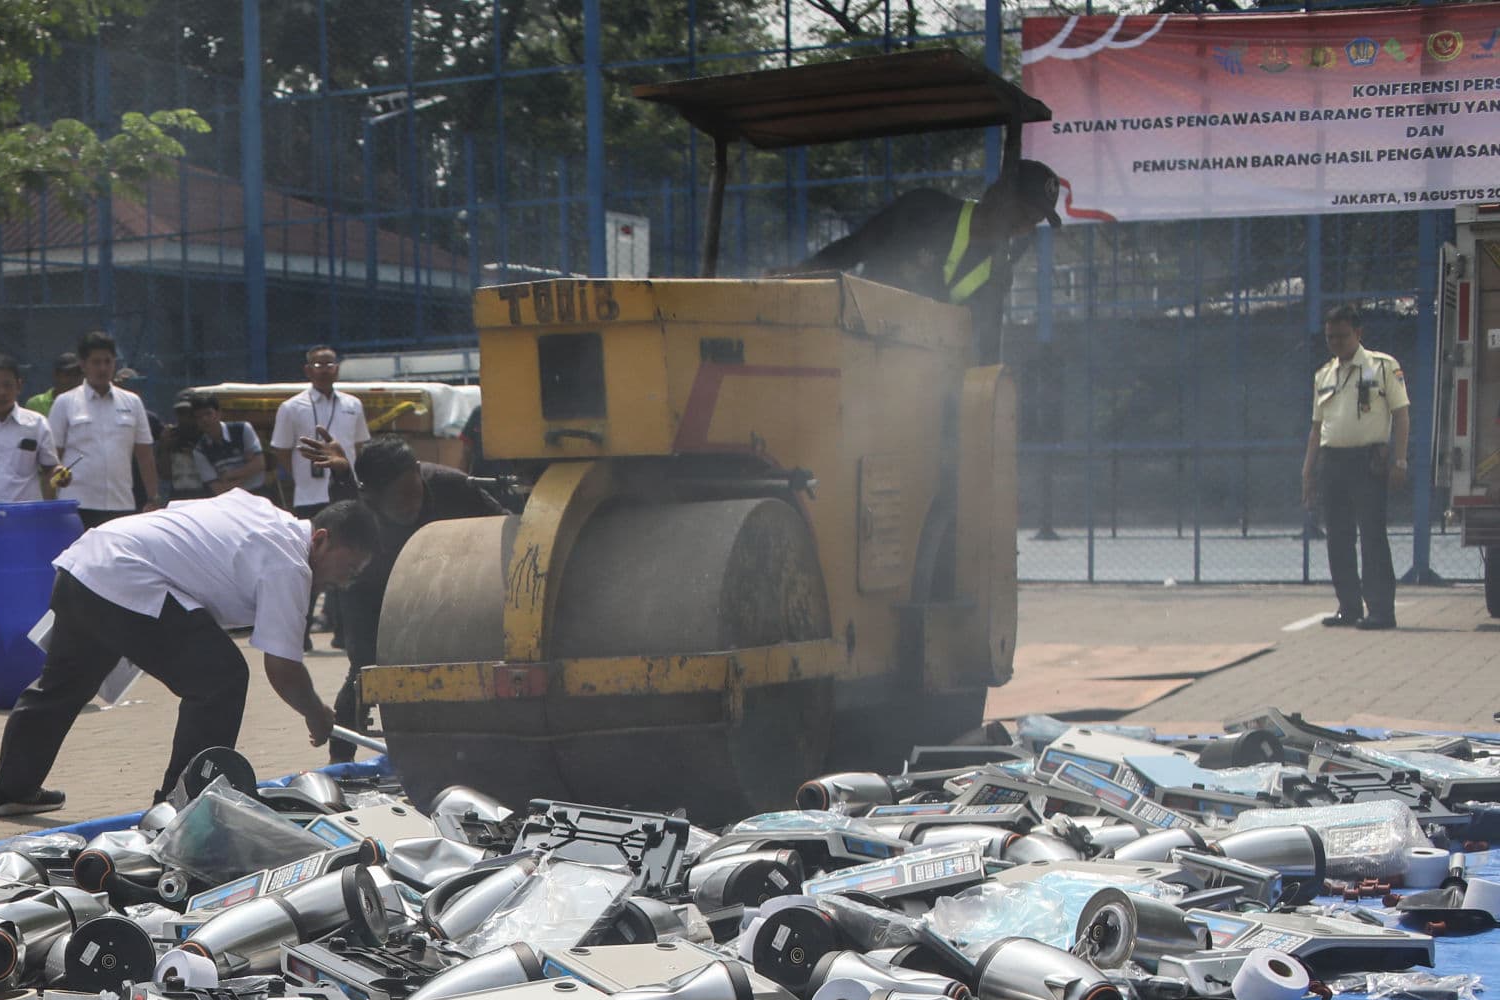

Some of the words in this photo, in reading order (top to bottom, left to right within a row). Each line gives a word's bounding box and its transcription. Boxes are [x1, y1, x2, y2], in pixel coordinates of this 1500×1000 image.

[1352, 80, 1460, 98] KONFERENSI
[1463, 78, 1500, 92] PERS
[1052, 119, 1118, 135] SATUAN
[1120, 116, 1174, 131] TUGAS
[1176, 110, 1296, 128] PENGAWASAN
[1299, 107, 1373, 122] BARANG
[1374, 102, 1461, 119] TERTENTU
[1406, 124, 1445, 138] DAN
[1132, 156, 1248, 173] PEMUSNAHAN
[1251, 152, 1322, 168] BARANG
[1325, 150, 1373, 165] HASIL
[1376, 144, 1500, 162] PENGAWASAN
[1331, 192, 1401, 205] JAKARTA,
[1403, 191, 1417, 202] 19
[1419, 189, 1485, 202] AGUSTUS
